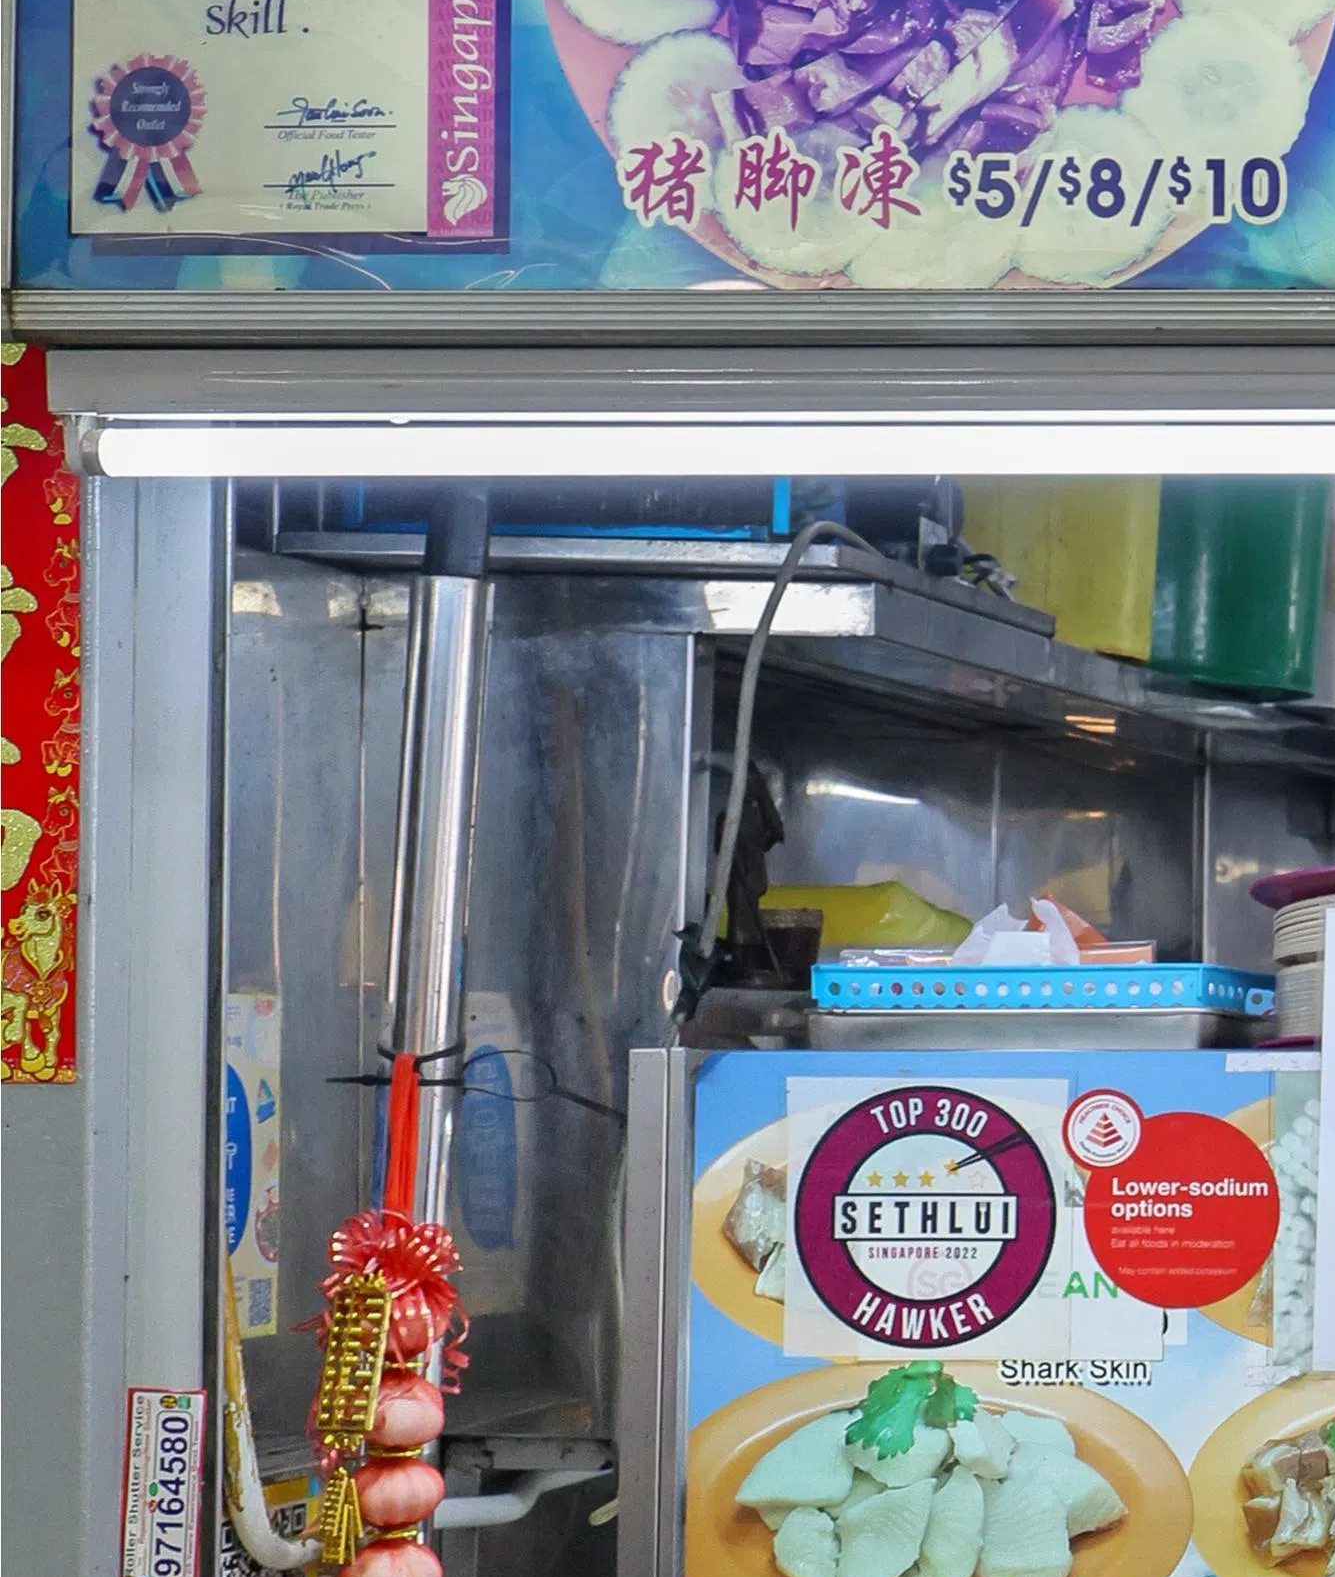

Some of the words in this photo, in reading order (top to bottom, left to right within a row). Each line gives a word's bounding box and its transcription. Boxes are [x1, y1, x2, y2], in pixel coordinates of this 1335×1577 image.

[318, 129, 345, 140] Food
[347, 129, 377, 140] Tester
[947, 156, 1281, 226] $5/$8/$10
[870, 1098, 924, 1137] TOP
[934, 1096, 989, 1139] 300
[1111, 1177, 1269, 1197] Lower-sodium
[840, 1200, 1012, 1236] SETHLUI
[1111, 1199, 1193, 1221] options
[867, 1245, 941, 1260] SINGAPORE
[944, 1245, 979, 1260] 2022
[851, 1291, 995, 1340] HAWKER
[1000, 1360, 1081, 1380] Shark
[1089, 1360, 1149, 1380] Skin
[132, 1395, 145, 1459] Service
[128, 1465, 140, 1525] Shutter
[154, 1415, 190, 1577] 97164580
